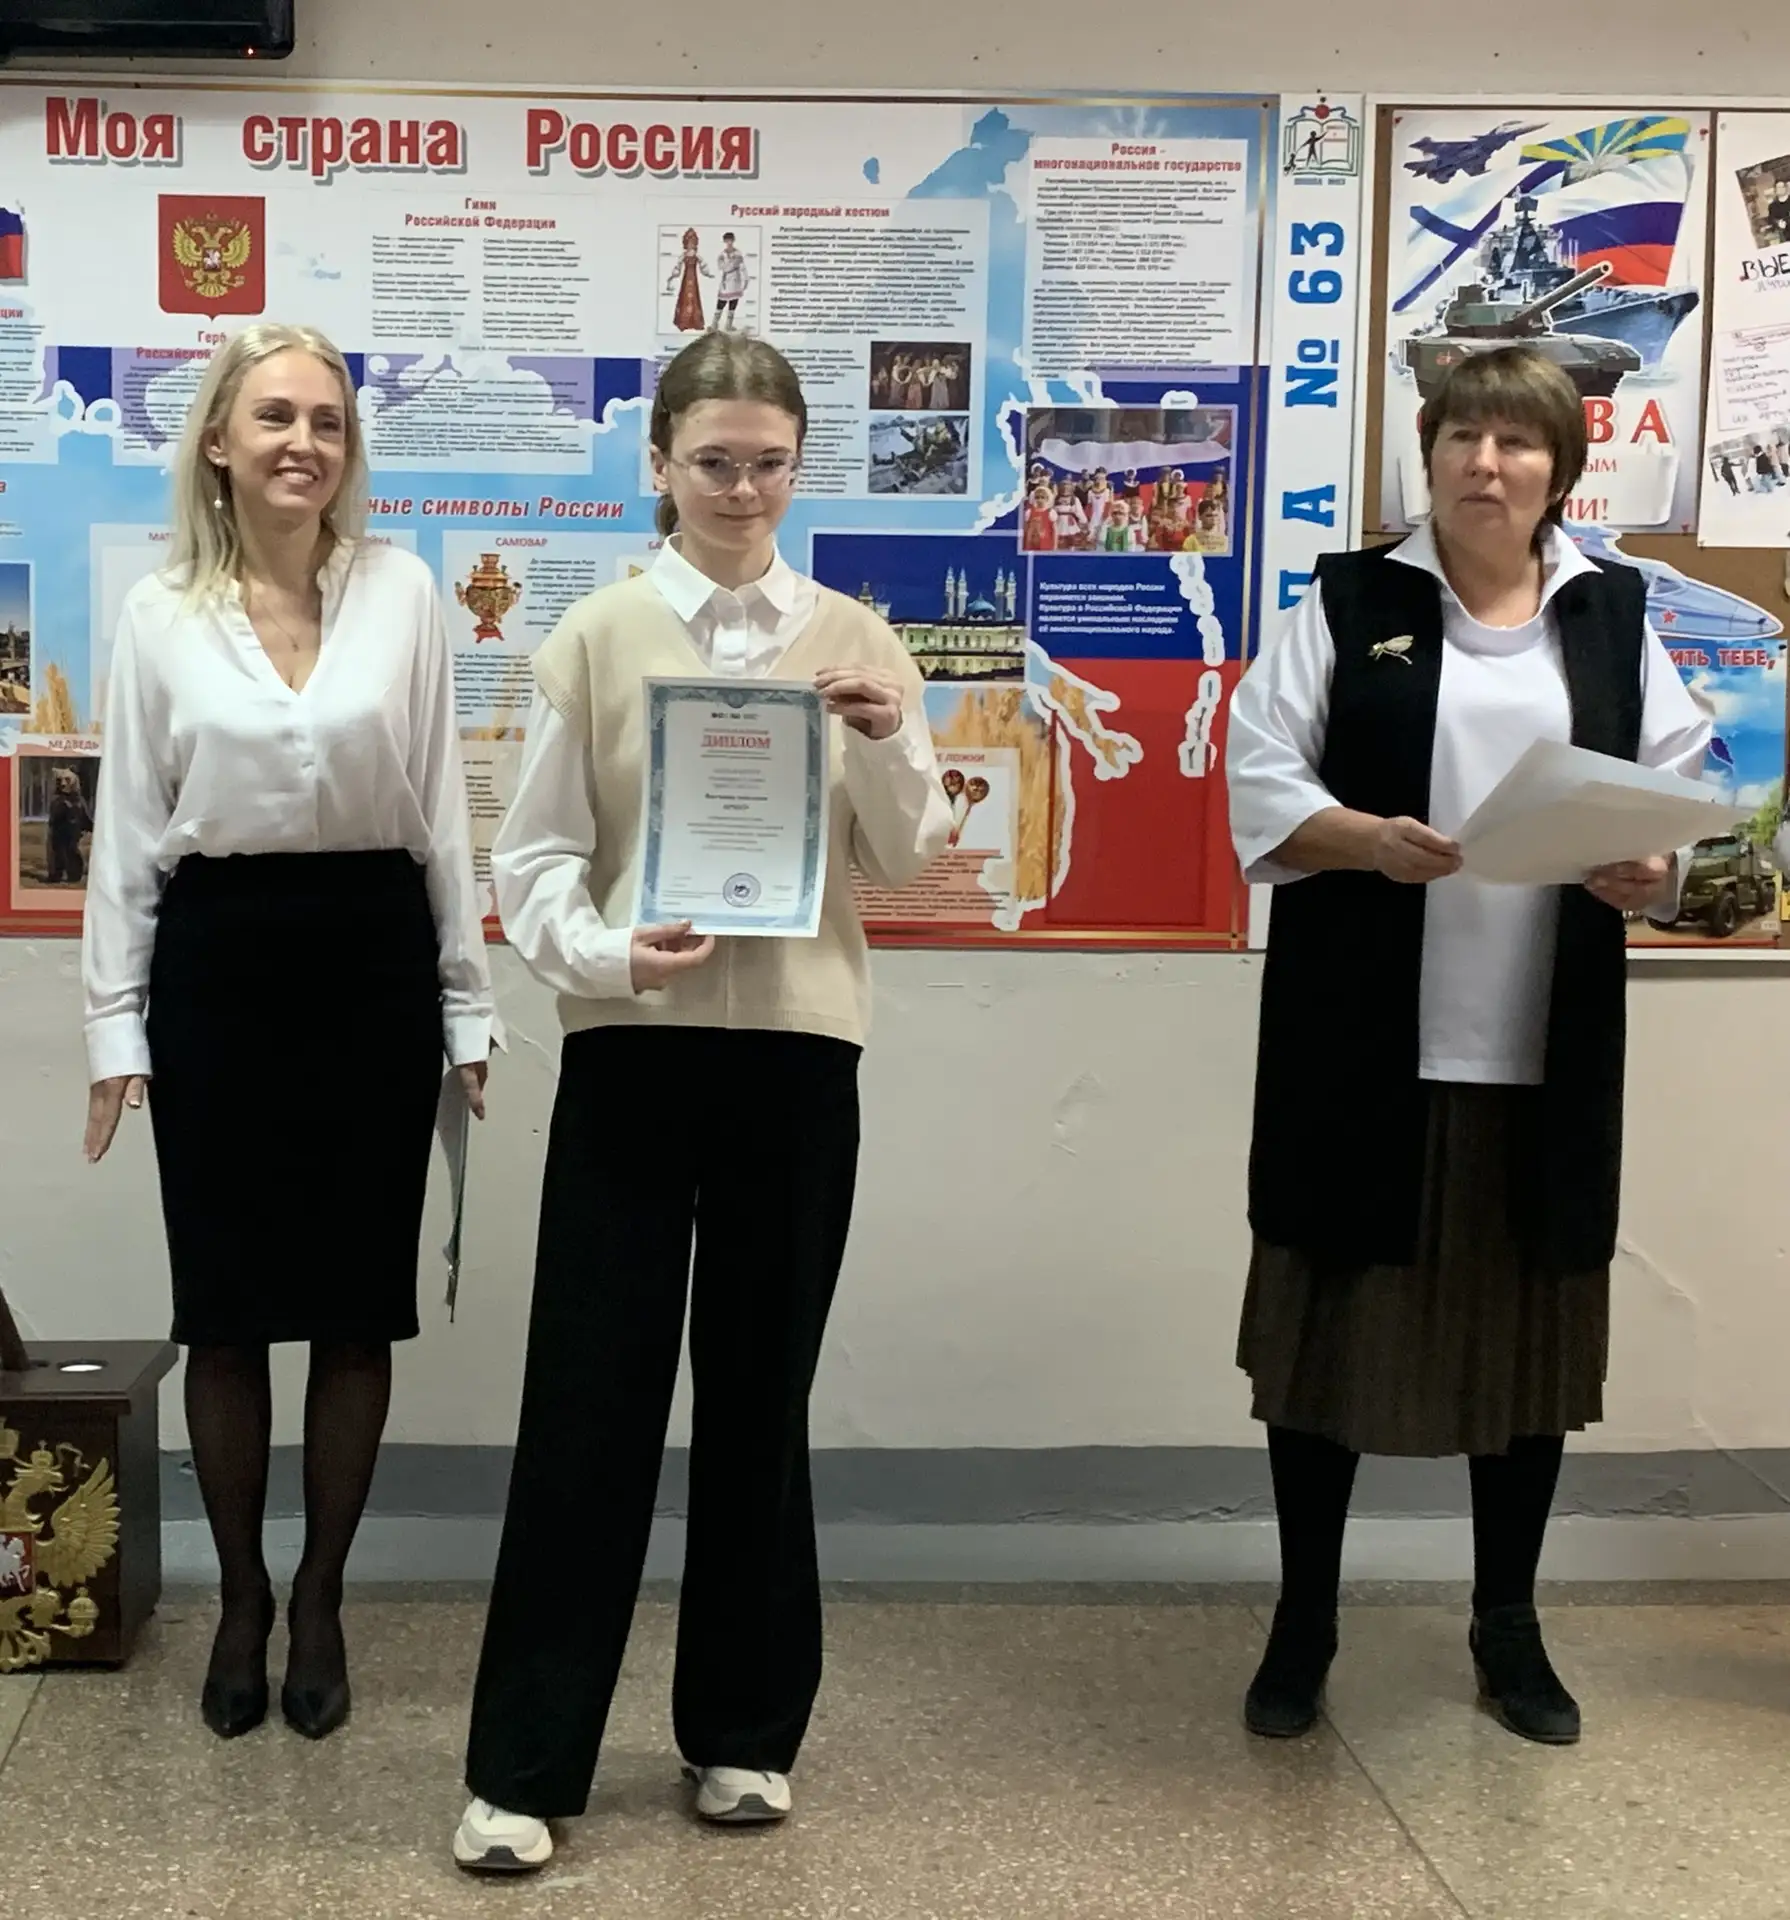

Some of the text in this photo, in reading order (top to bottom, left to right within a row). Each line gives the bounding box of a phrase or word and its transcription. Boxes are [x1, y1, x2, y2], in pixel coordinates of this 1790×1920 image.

[46, 97, 754, 180] Моя страна Россия
[1112, 142, 1156, 155] Россия
[1034, 159, 1241, 173] многонациональное государство
[465, 198, 496, 210] Гимн
[731, 204, 890, 218] Русский народный костюм
[405, 214, 556, 230] Российской Федерации
[198, 330, 227, 345] Герб
[423, 498, 529, 517] символы
[538, 497, 625, 518] России
[495, 537, 548, 548] САМОВАР
[1669, 649, 1710, 666] ИТЬ
[48, 740, 99, 750] МЕДВЕДЬ
[701, 734, 771, 749] ДИПЛОМ
